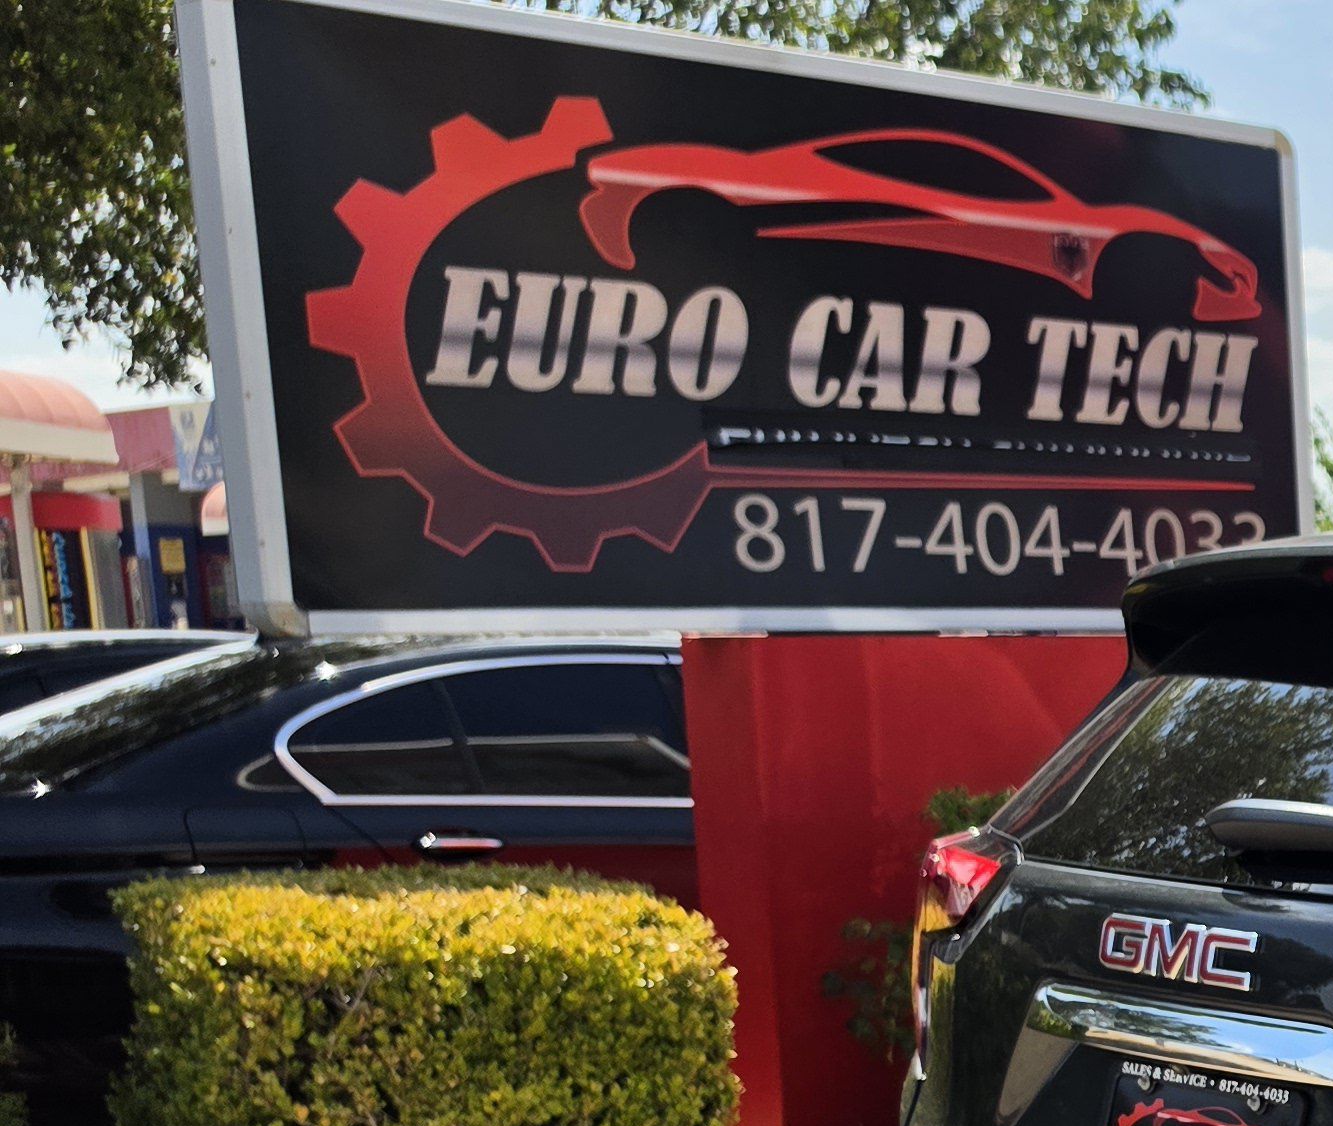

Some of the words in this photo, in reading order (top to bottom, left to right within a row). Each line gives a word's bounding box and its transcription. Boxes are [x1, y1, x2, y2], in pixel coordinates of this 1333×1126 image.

[426, 265, 752, 402] EURO
[786, 295, 994, 416] CAR
[1025, 317, 1260, 434] TECH
[1099, 912, 1259, 992] GMC
[1122, 1061, 1152, 1080] SALES
